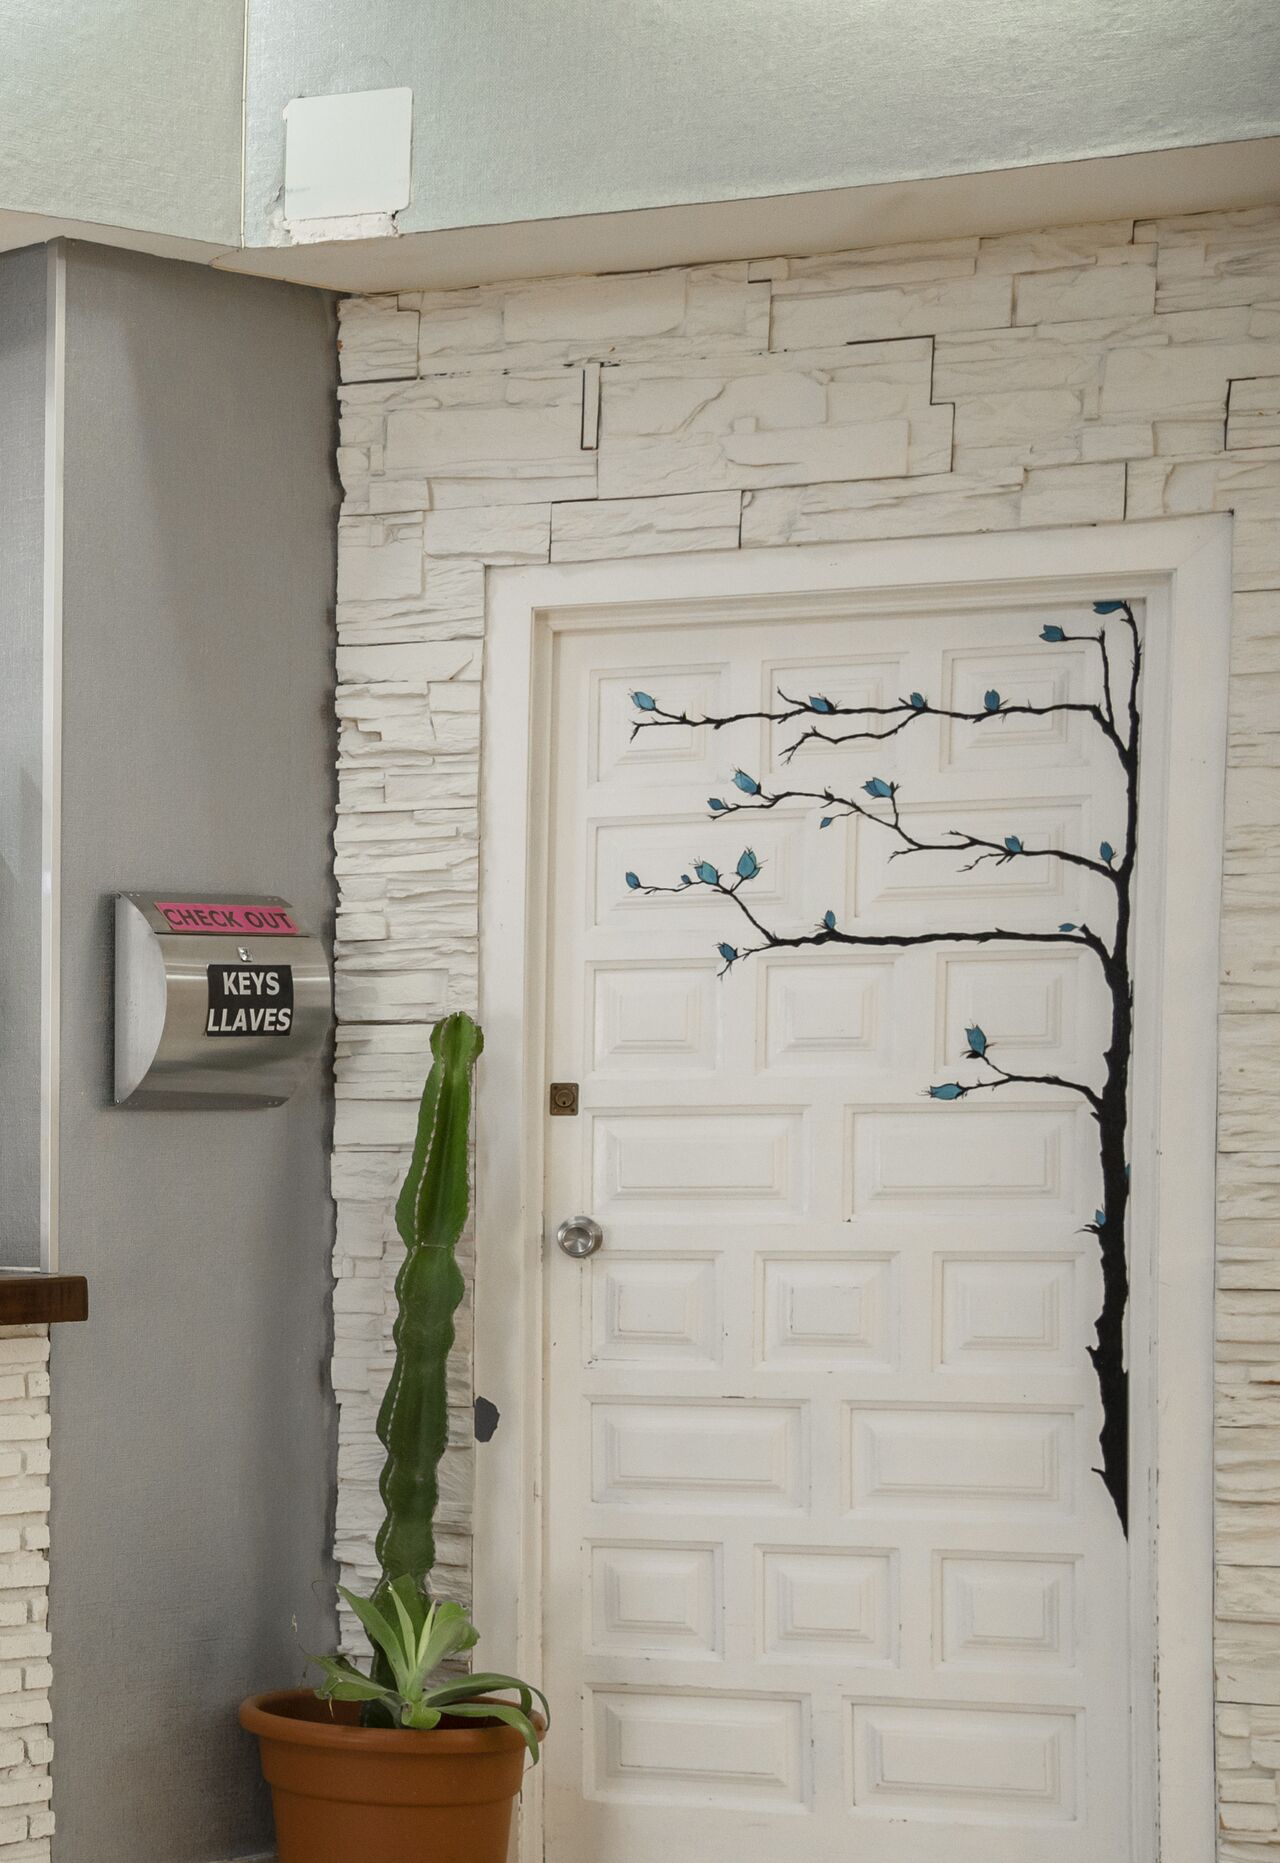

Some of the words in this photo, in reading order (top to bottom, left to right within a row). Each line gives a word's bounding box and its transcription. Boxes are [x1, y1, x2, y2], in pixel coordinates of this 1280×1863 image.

[163, 908, 242, 928] CHECK
[244, 911, 292, 929] OUT
[222, 972, 280, 996] KEYS
[208, 1008, 291, 1032] LLAVES
